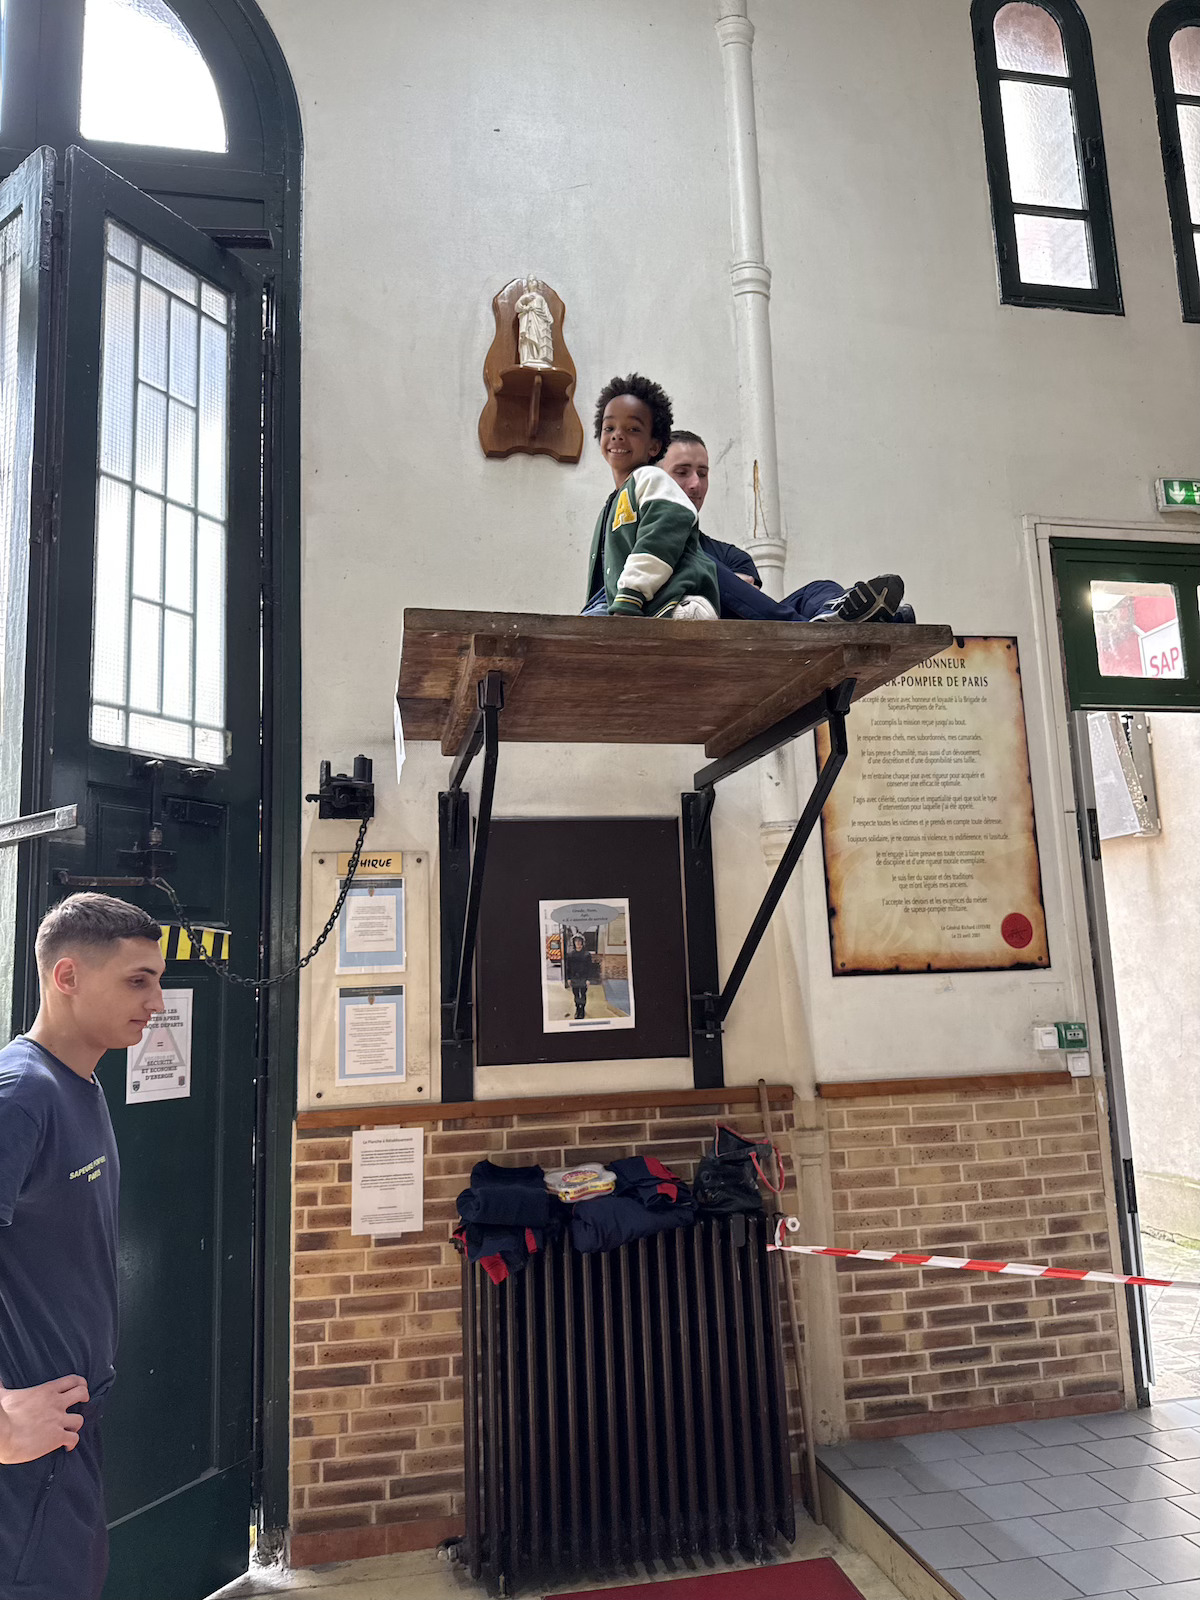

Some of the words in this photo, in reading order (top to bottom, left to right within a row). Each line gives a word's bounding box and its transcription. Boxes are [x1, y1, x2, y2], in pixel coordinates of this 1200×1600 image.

[612, 488, 637, 531] A
[947, 676, 959, 687] DE
[962, 676, 989, 688] PARIS
